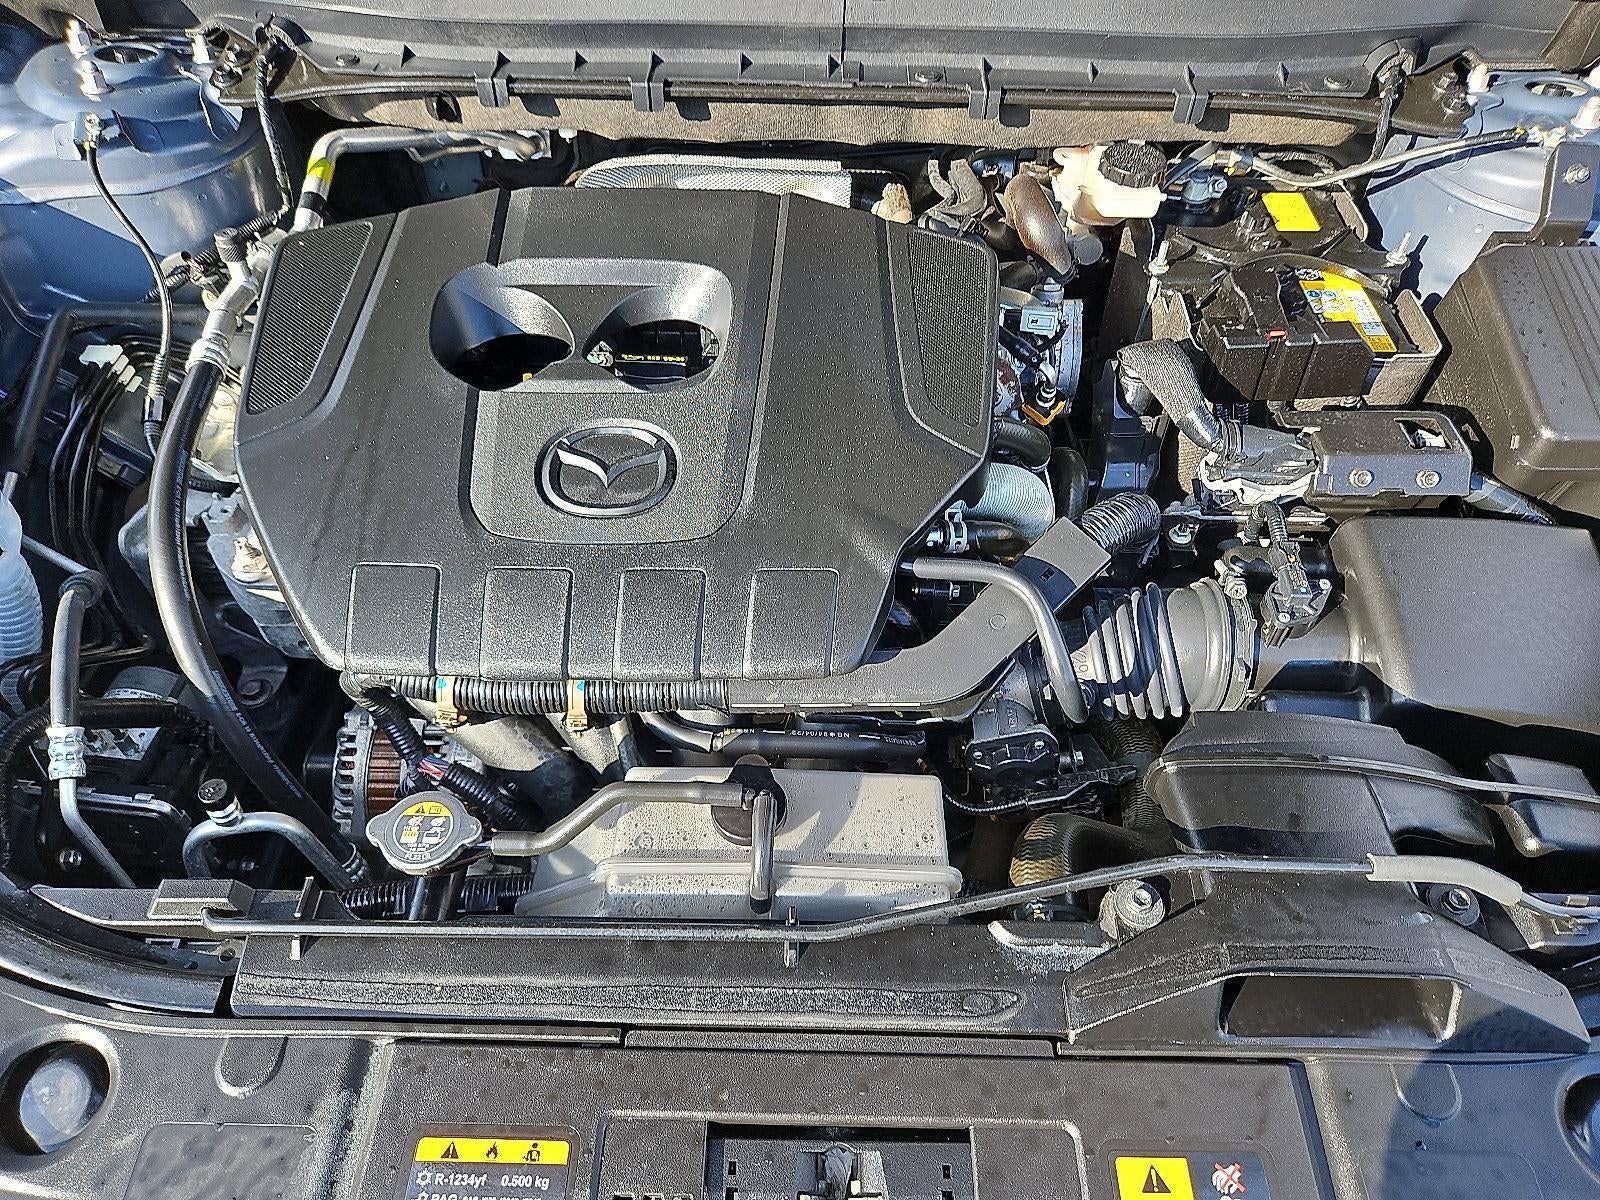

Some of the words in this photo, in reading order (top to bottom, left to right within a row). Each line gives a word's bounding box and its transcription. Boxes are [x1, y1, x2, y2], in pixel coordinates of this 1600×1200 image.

[435, 1173, 488, 1189] R-1234yf
[501, 1174, 533, 1188] 0.500
[534, 1174, 550, 1191] kg
